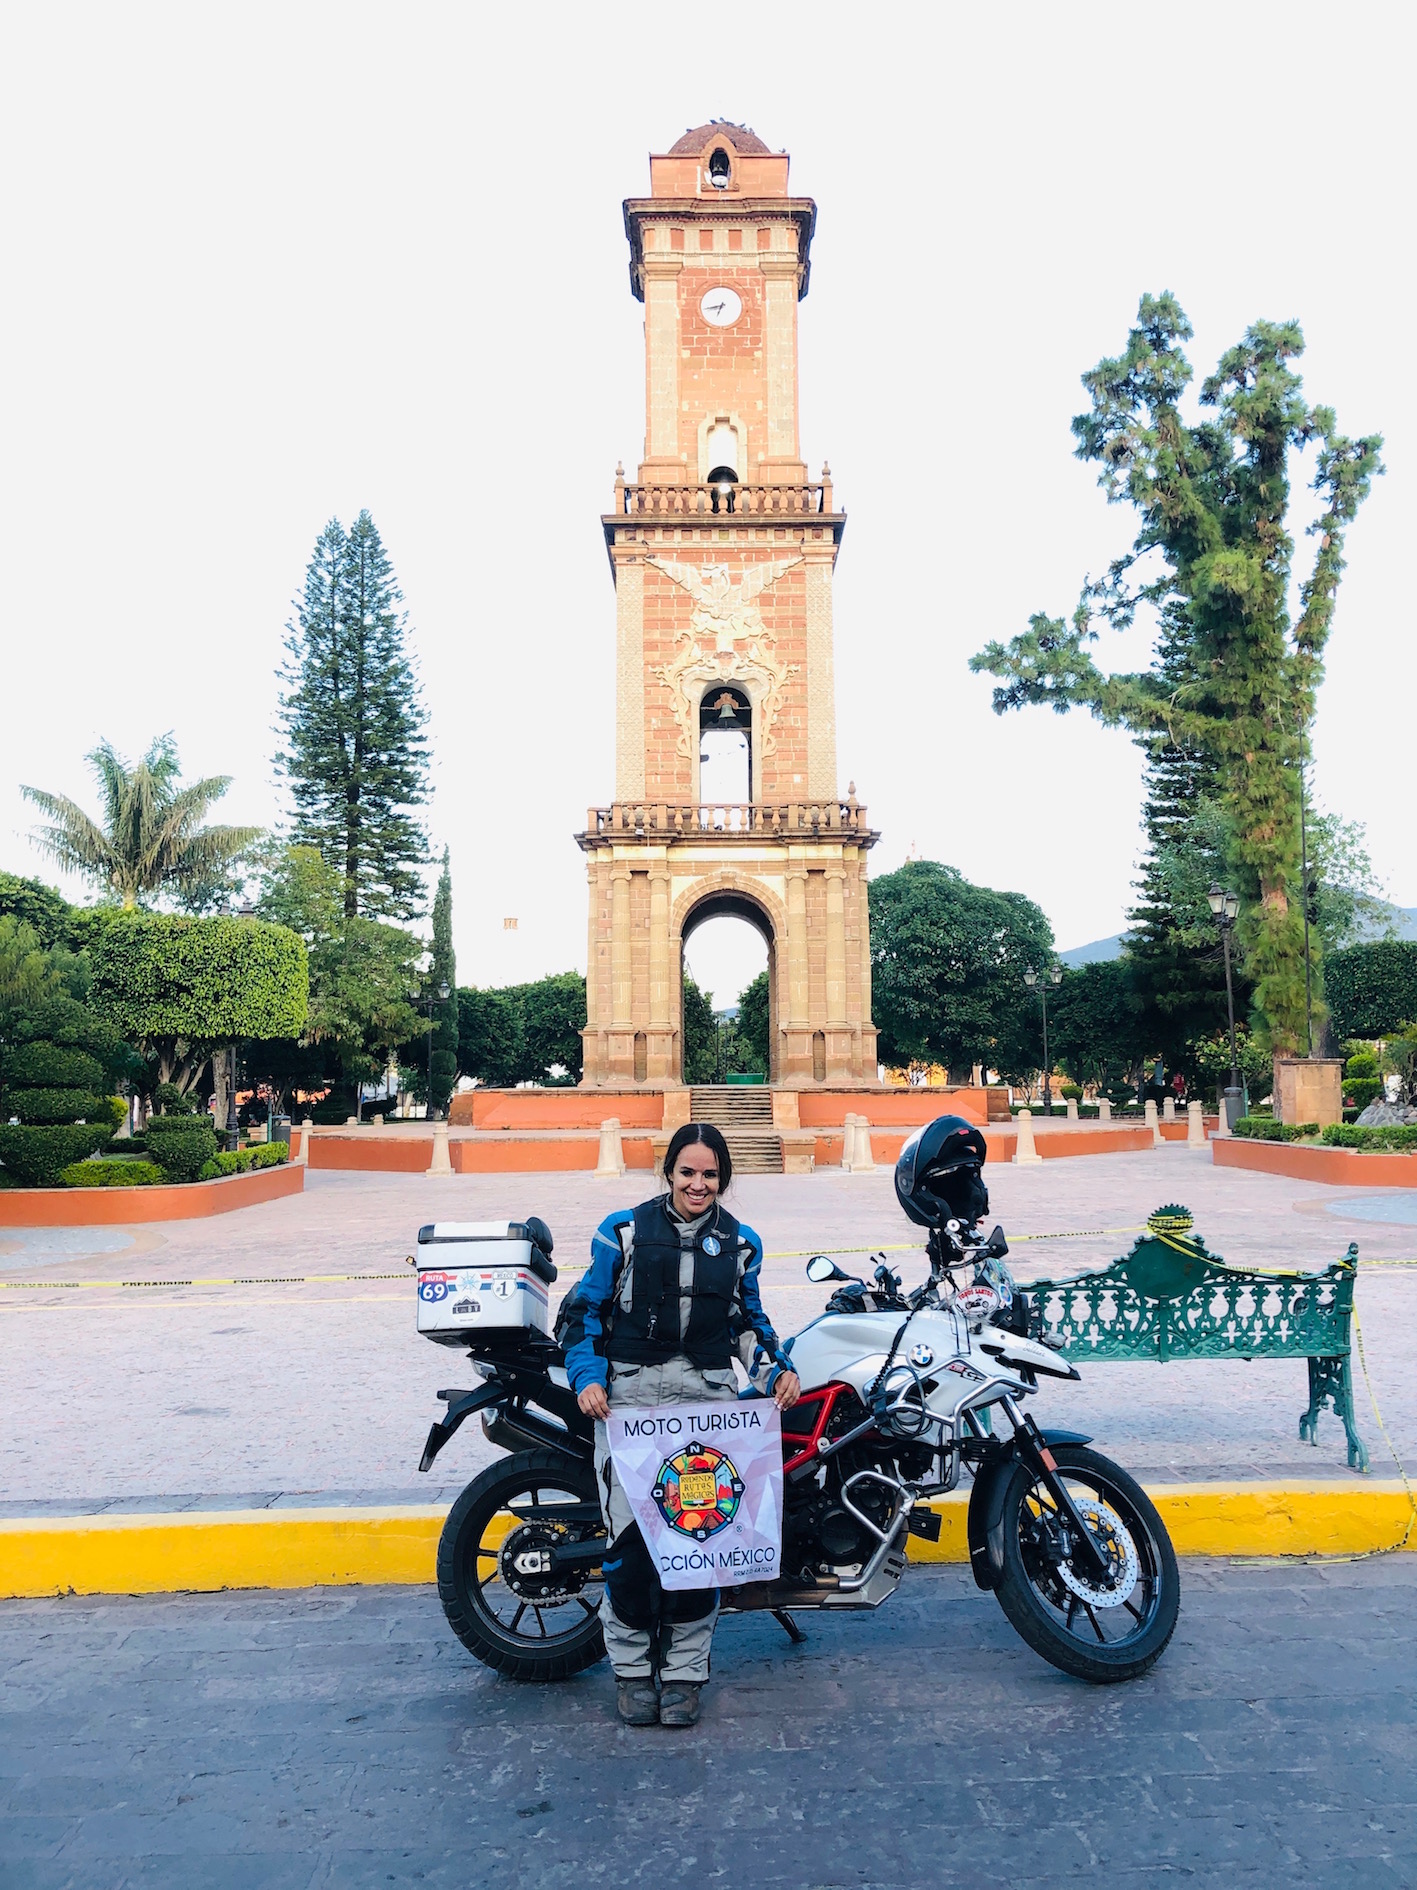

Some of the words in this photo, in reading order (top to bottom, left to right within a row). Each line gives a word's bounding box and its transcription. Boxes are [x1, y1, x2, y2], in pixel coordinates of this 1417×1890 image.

[423, 1283, 445, 1300] 69
[624, 1417, 682, 1437] MOTO
[688, 1410, 762, 1433] TURISTA
[689, 1444, 701, 1453] N
[734, 1483, 743, 1491] E
[653, 1489, 664, 1498] O
[696, 1530, 707, 1539] S
[719, 1545, 776, 1569] MÉXICO
